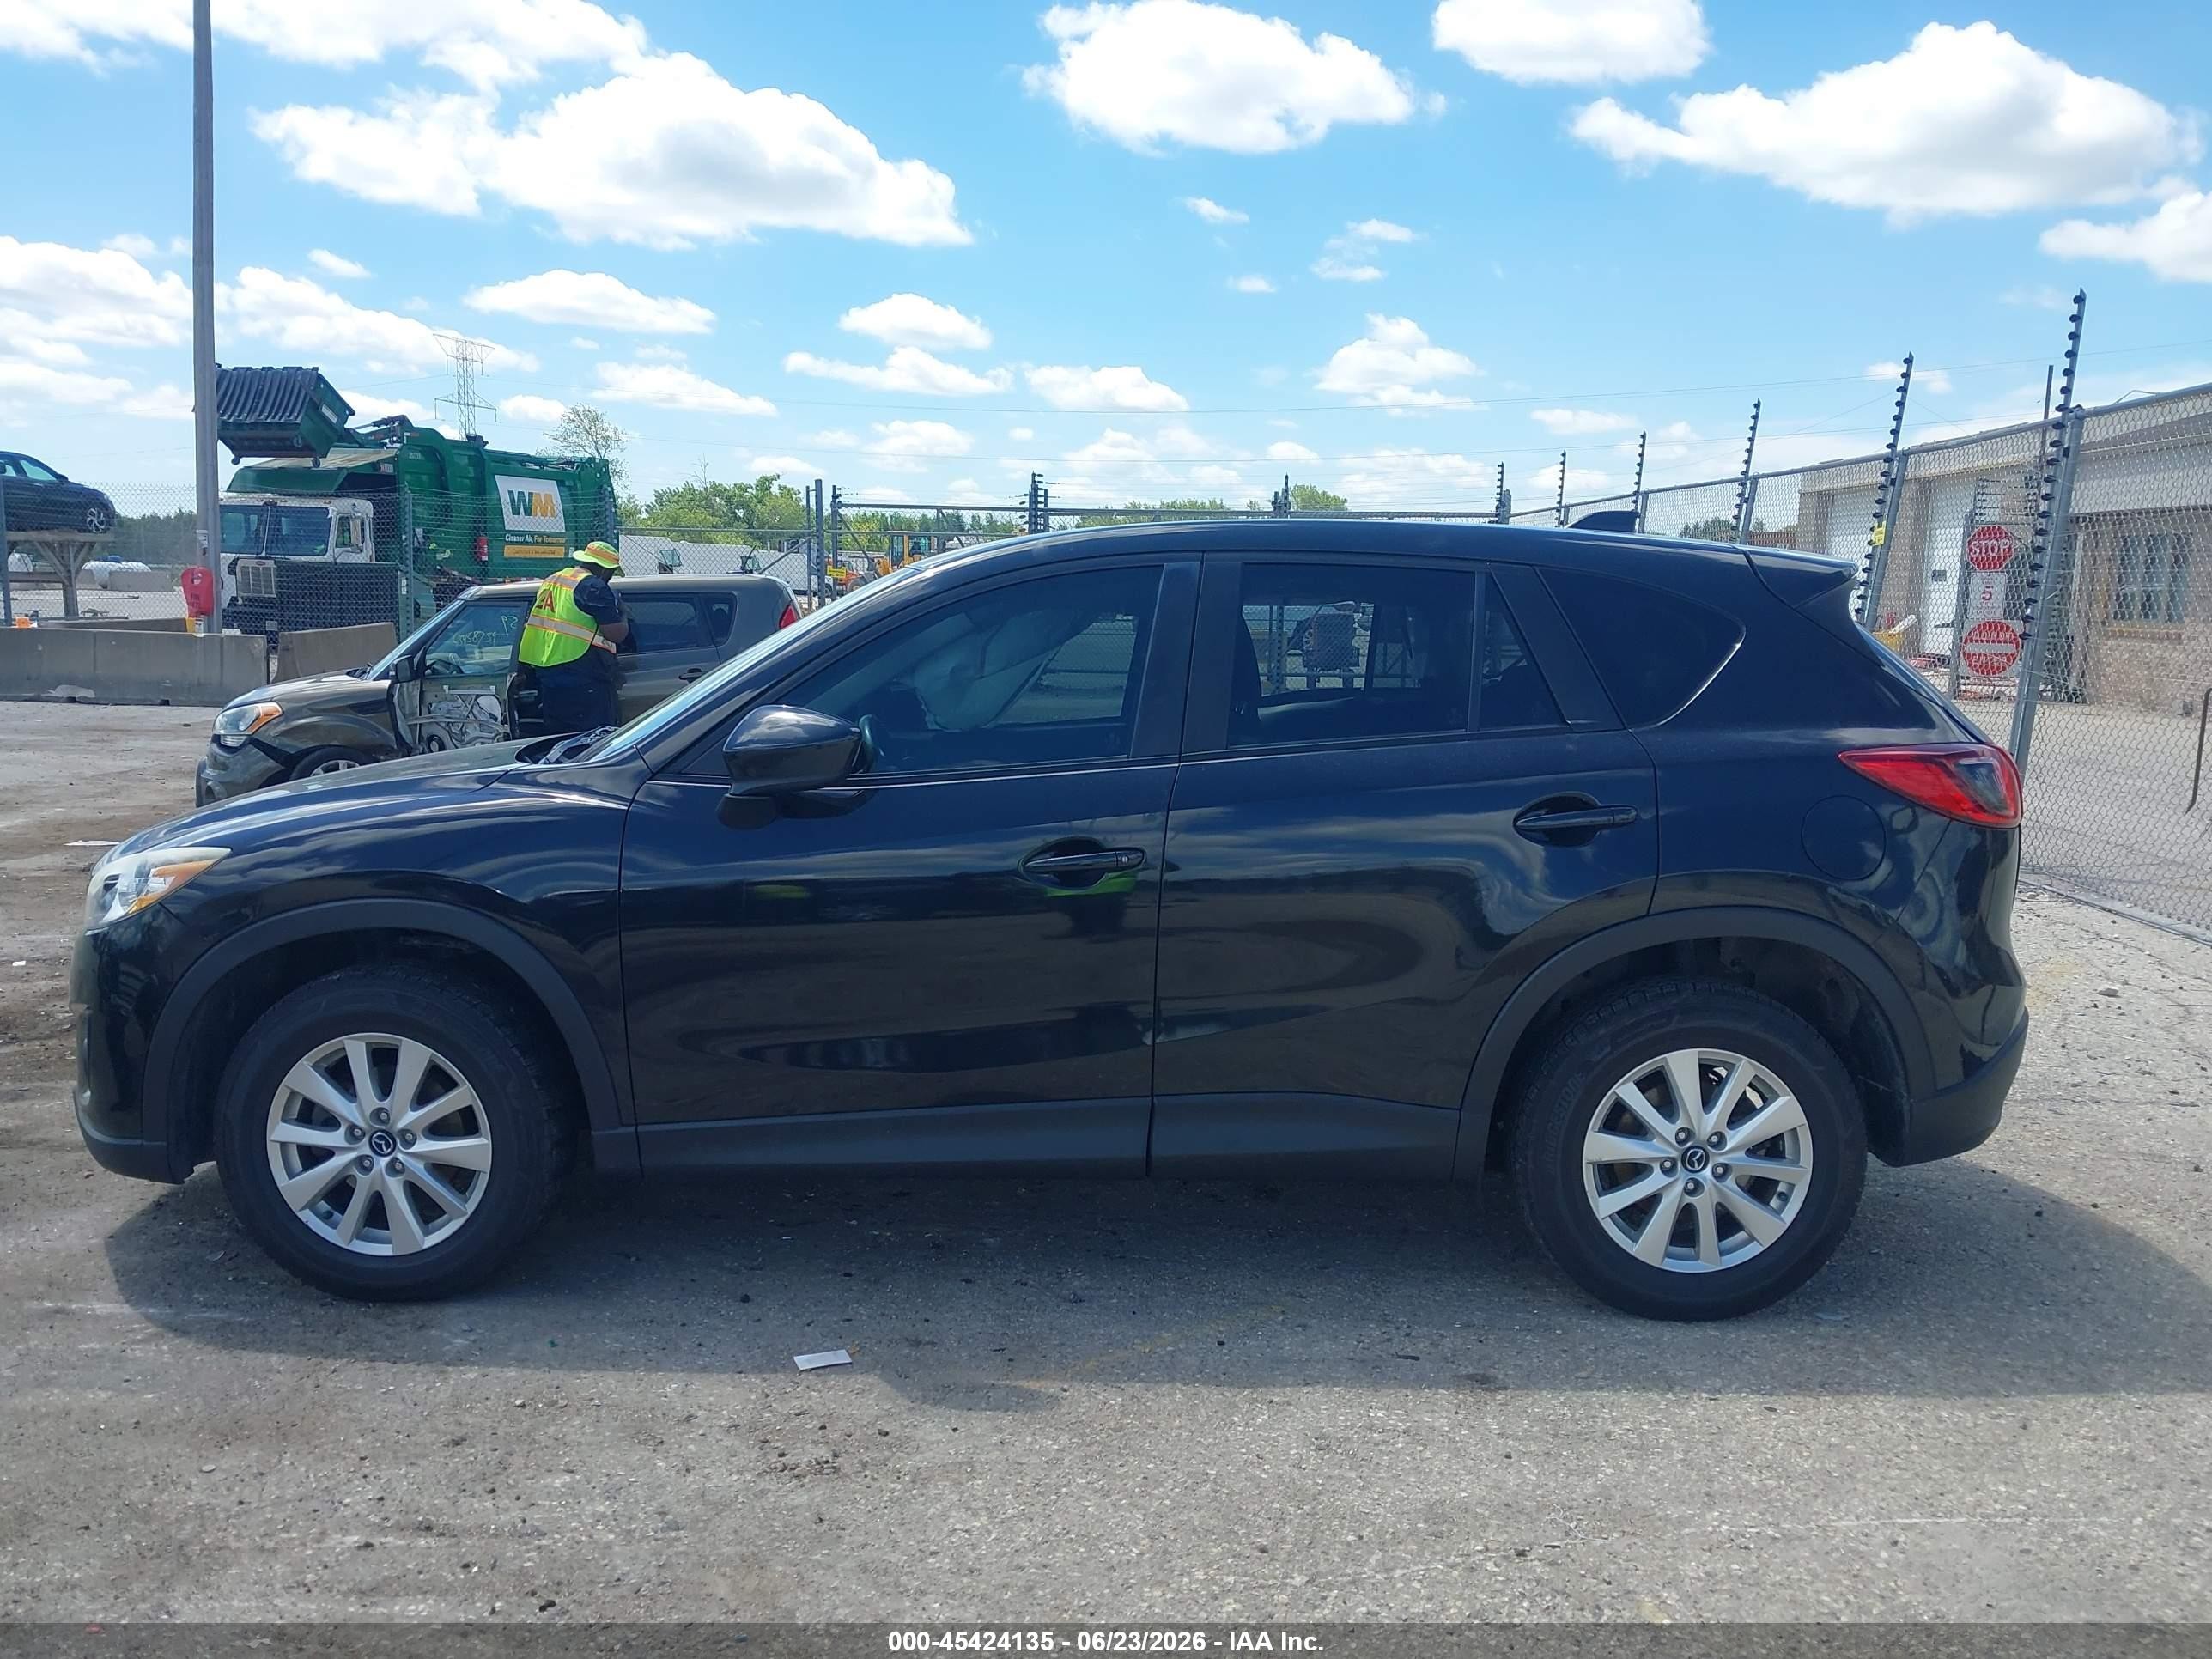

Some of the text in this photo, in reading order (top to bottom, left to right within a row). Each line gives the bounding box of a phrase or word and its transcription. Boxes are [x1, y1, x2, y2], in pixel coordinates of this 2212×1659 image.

[507, 489, 556, 517] WM
[505, 533, 524, 542] Cleaner
[1970, 539, 2010, 557] STOP
[1982, 586, 1994, 601] 5
